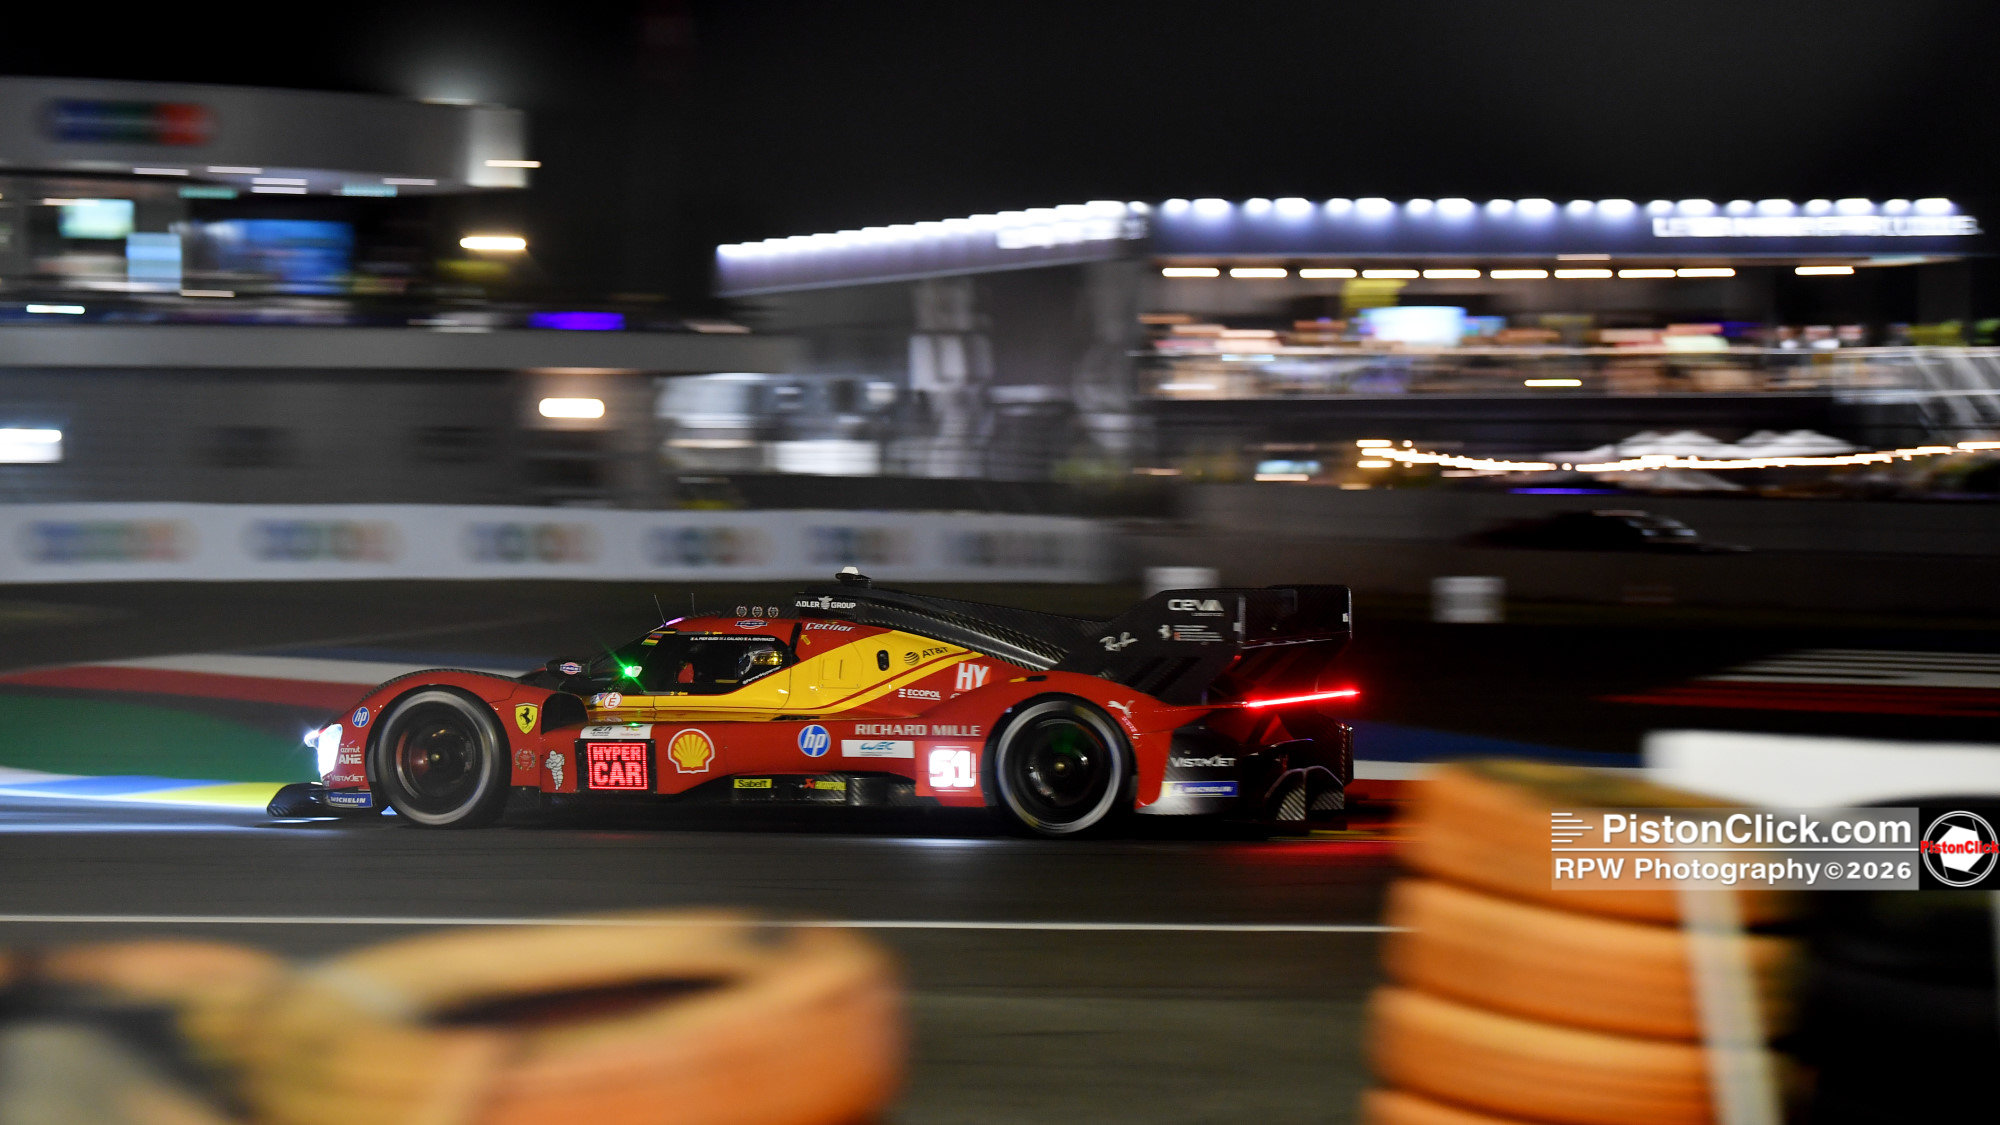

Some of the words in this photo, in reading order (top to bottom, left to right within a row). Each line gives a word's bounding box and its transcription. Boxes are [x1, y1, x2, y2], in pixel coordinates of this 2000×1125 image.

[795, 600, 820, 609] ADLER
[830, 601, 857, 610] GROUP
[1167, 598, 1224, 611] CEVA
[804, 622, 856, 633] Cetilar
[922, 646, 949, 658] AT&T
[955, 662, 989, 690] HY
[907, 688, 941, 697] ECOPOL
[354, 708, 367, 726] hp
[855, 724, 928, 735] RICHARD
[931, 725, 981, 736] MILLE
[802, 725, 825, 756] hp
[860, 741, 895, 751] WEC
[592, 746, 642, 761] HYPER
[593, 761, 642, 786] CAR
[929, 749, 976, 788] 51
